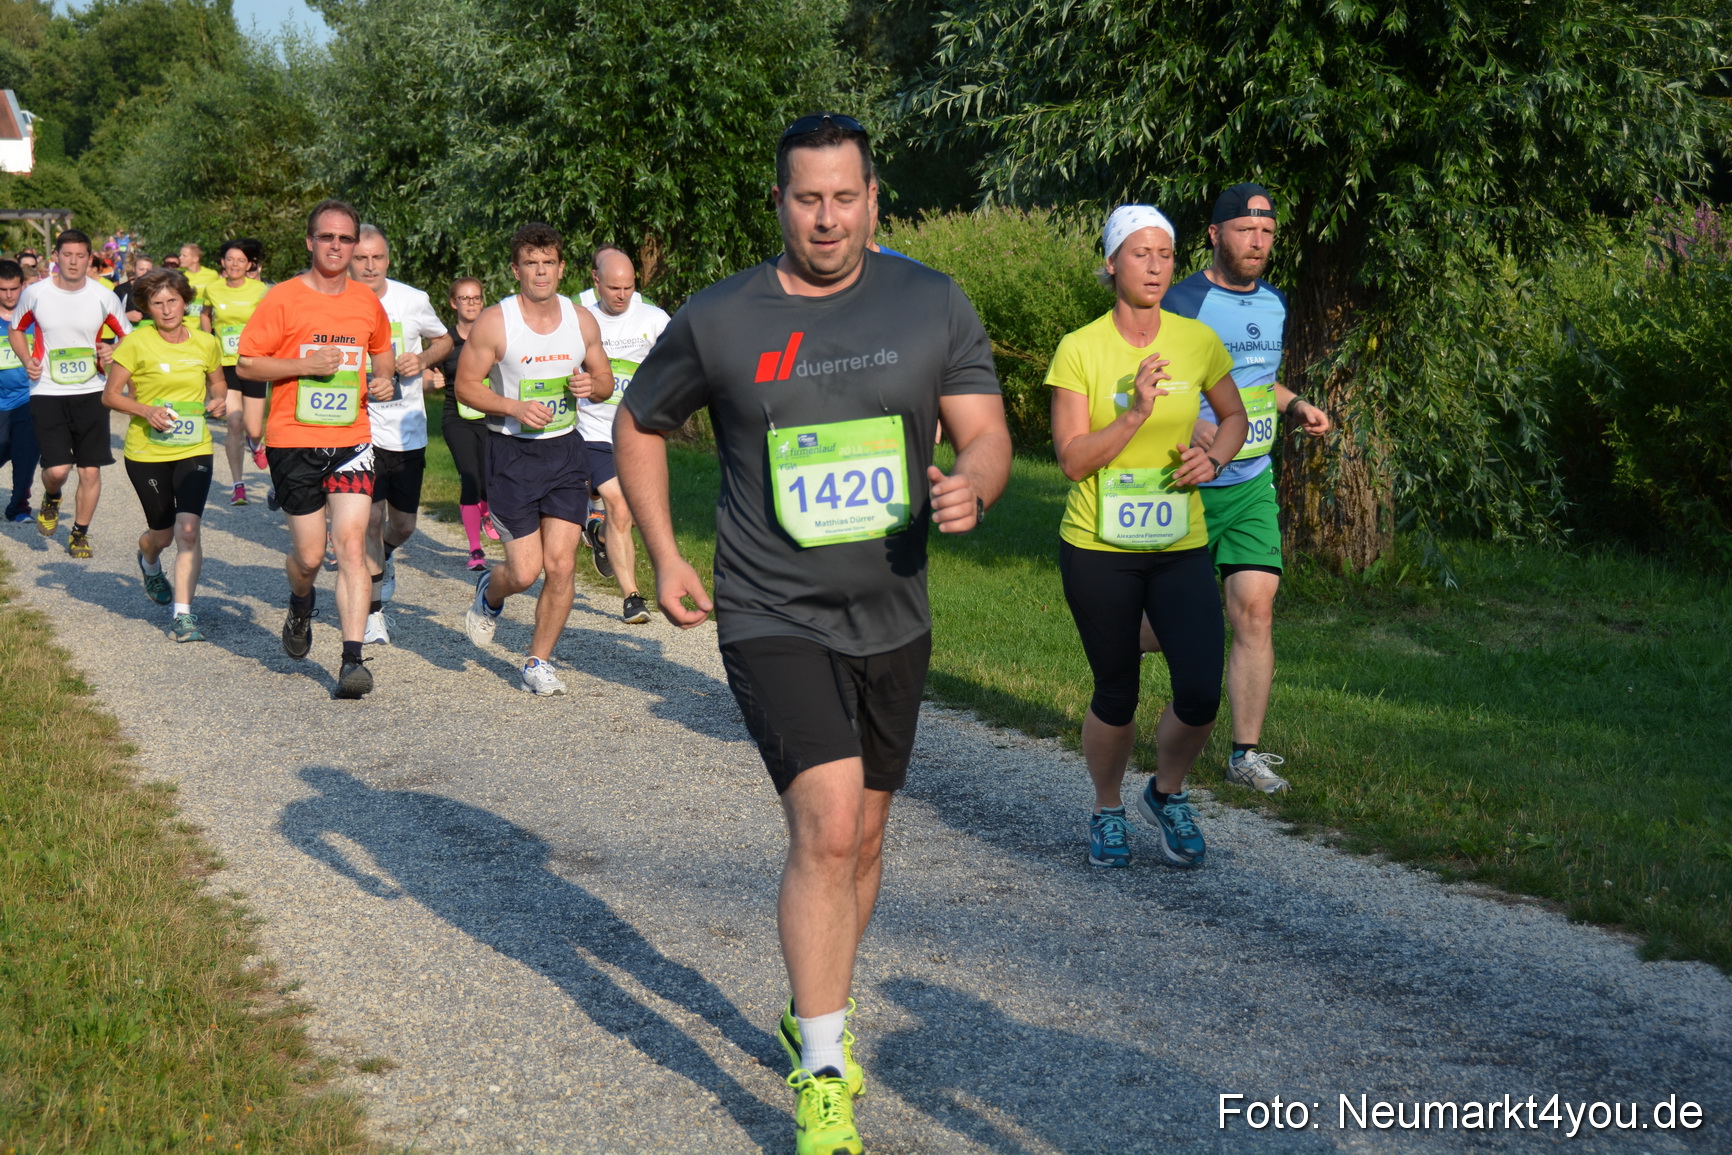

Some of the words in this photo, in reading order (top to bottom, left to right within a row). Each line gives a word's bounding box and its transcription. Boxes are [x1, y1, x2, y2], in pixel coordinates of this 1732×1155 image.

[312, 334, 328, 343] 30
[330, 334, 356, 344] Jahre
[535, 354, 573, 362] KLEBL
[795, 349, 898, 377] duerrer.de
[1245, 356, 1266, 364] TEAM
[60, 361, 87, 374] 830
[310, 392, 348, 410] 622
[790, 443, 837, 457] firmenlauf
[789, 467, 895, 513] 1420
[1118, 501, 1173, 528] 670
[814, 517, 849, 528] Matthias
[849, 515, 876, 524] Dürrer
